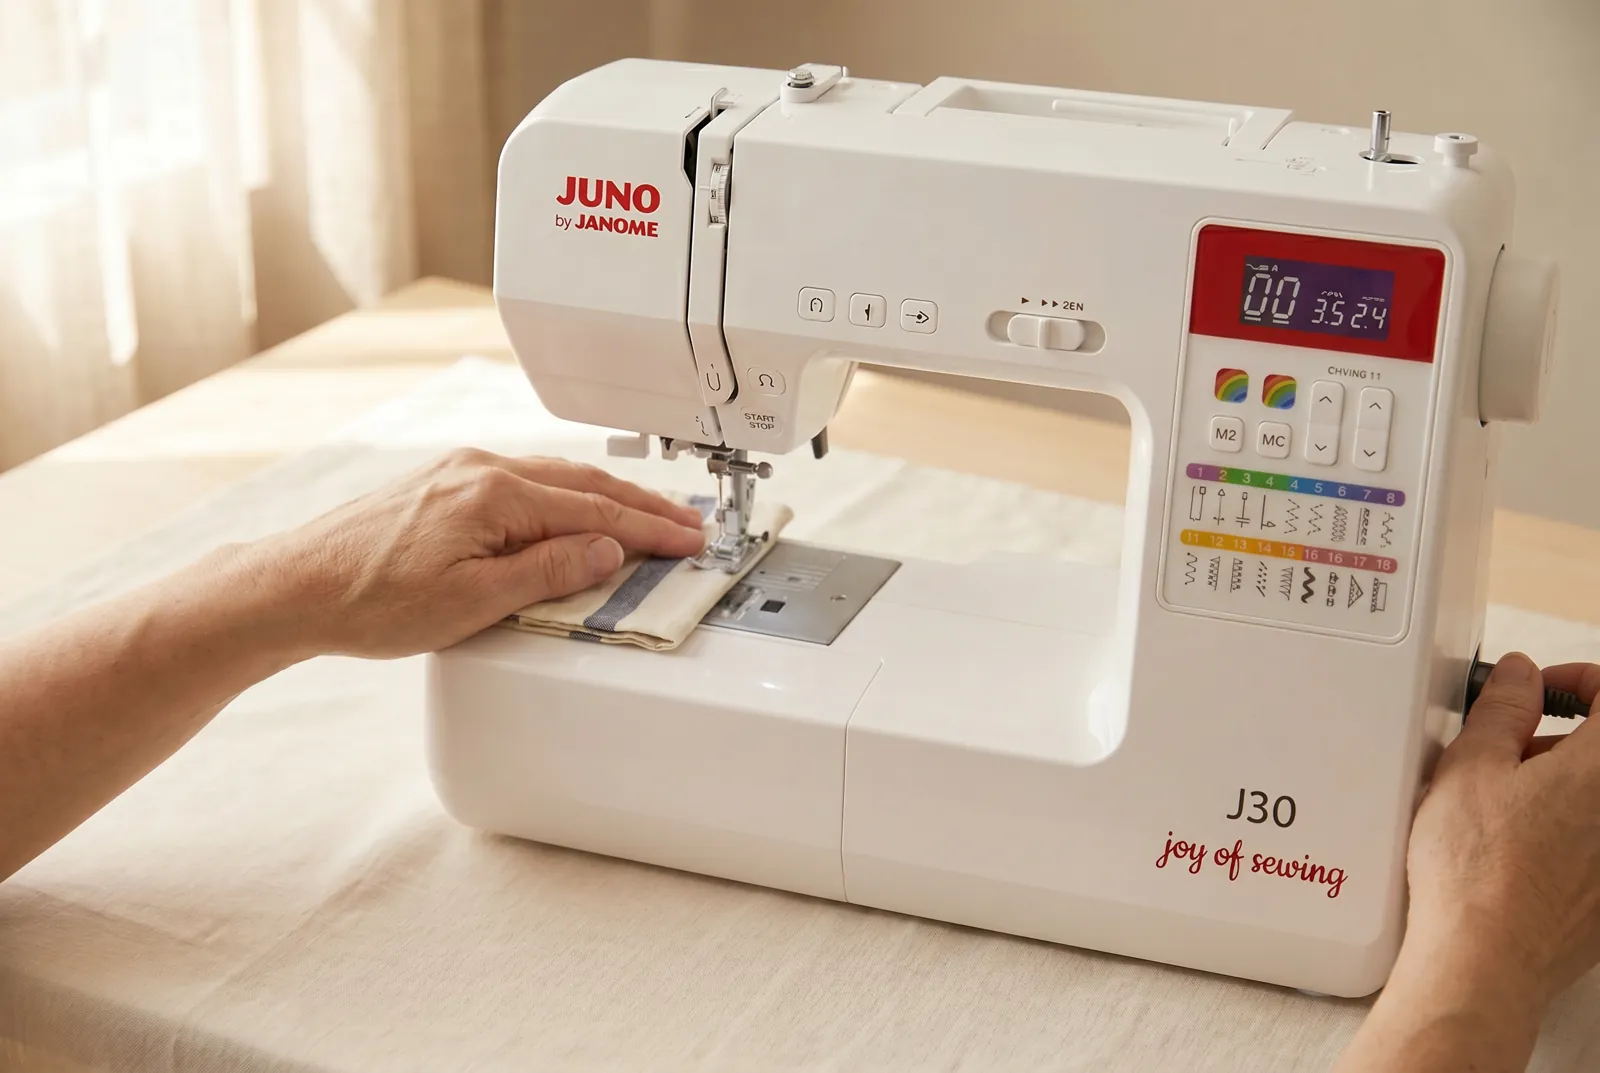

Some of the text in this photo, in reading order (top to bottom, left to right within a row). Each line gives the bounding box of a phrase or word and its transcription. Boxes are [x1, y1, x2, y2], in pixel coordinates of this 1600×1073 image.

[556, 176, 660, 213] JUNO
[556, 214, 658, 237] by JANOME
[1063, 301, 1084, 311] 2EN
[1244, 273, 1301, 320] 00
[1311, 299, 1345, 326] 3.5
[1328, 366, 1367, 379] CHVING
[744, 413, 775, 422] START
[749, 422, 774, 430] STOP
[1216, 428, 1236, 441] M2
[1262, 434, 1286, 447] MC
[1197, 467, 1395, 503] 1 2 3 4 4 5 6 7 8
[1187, 532, 1199, 543] 11
[1210, 535, 1224, 547] 12
[1233, 538, 1247, 549] 13
[1258, 542, 1271, 553] 14
[1304, 549, 1318, 560] 16
[1328, 552, 1342, 564] 16
[1353, 556, 1366, 567] 17
[1376, 559, 1391, 570] 18
[1226, 788, 1296, 828] J30
[1155, 831, 1348, 899] joy of sewing
